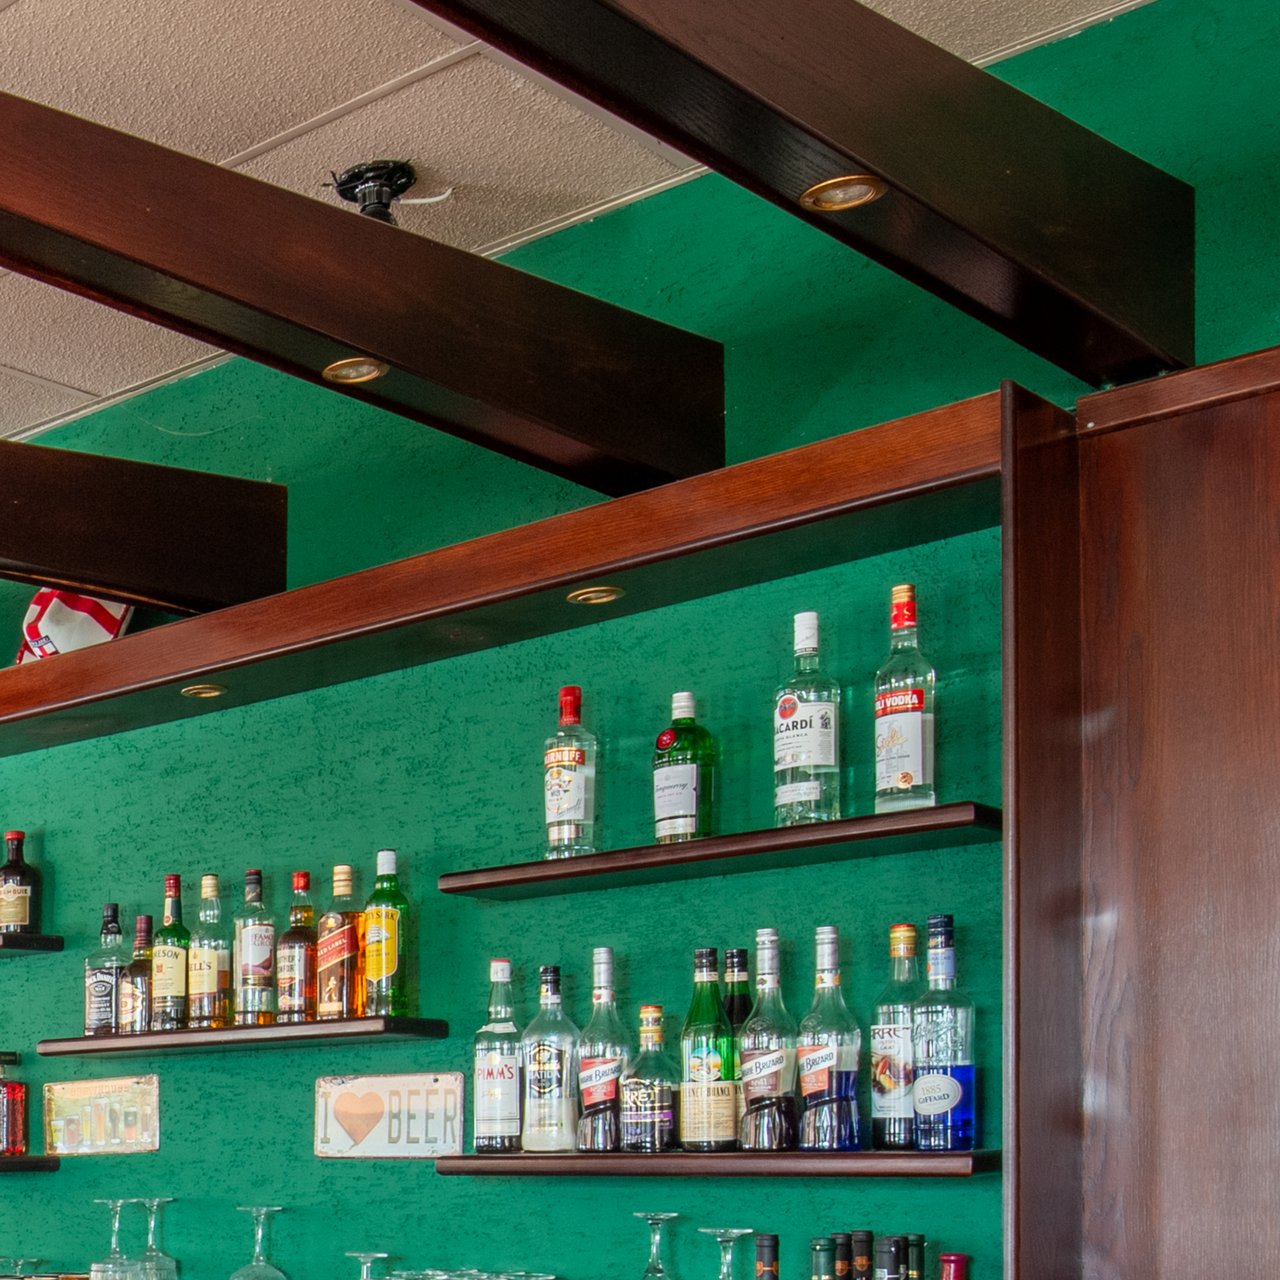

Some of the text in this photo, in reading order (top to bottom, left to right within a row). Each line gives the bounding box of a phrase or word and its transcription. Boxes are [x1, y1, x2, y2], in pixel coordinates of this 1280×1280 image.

[886, 694, 918, 707] VODKA
[545, 752, 582, 764] IRNOFF
[190, 961, 212, 971] ELL'S
[755, 1055, 784, 1074] BRIZARD
[477, 1064, 514, 1080] PIMM'S
[921, 1084, 941, 1095] 1885
[918, 1093, 950, 1105] GIFFARD
[320, 1088, 457, 1144] I BEER
